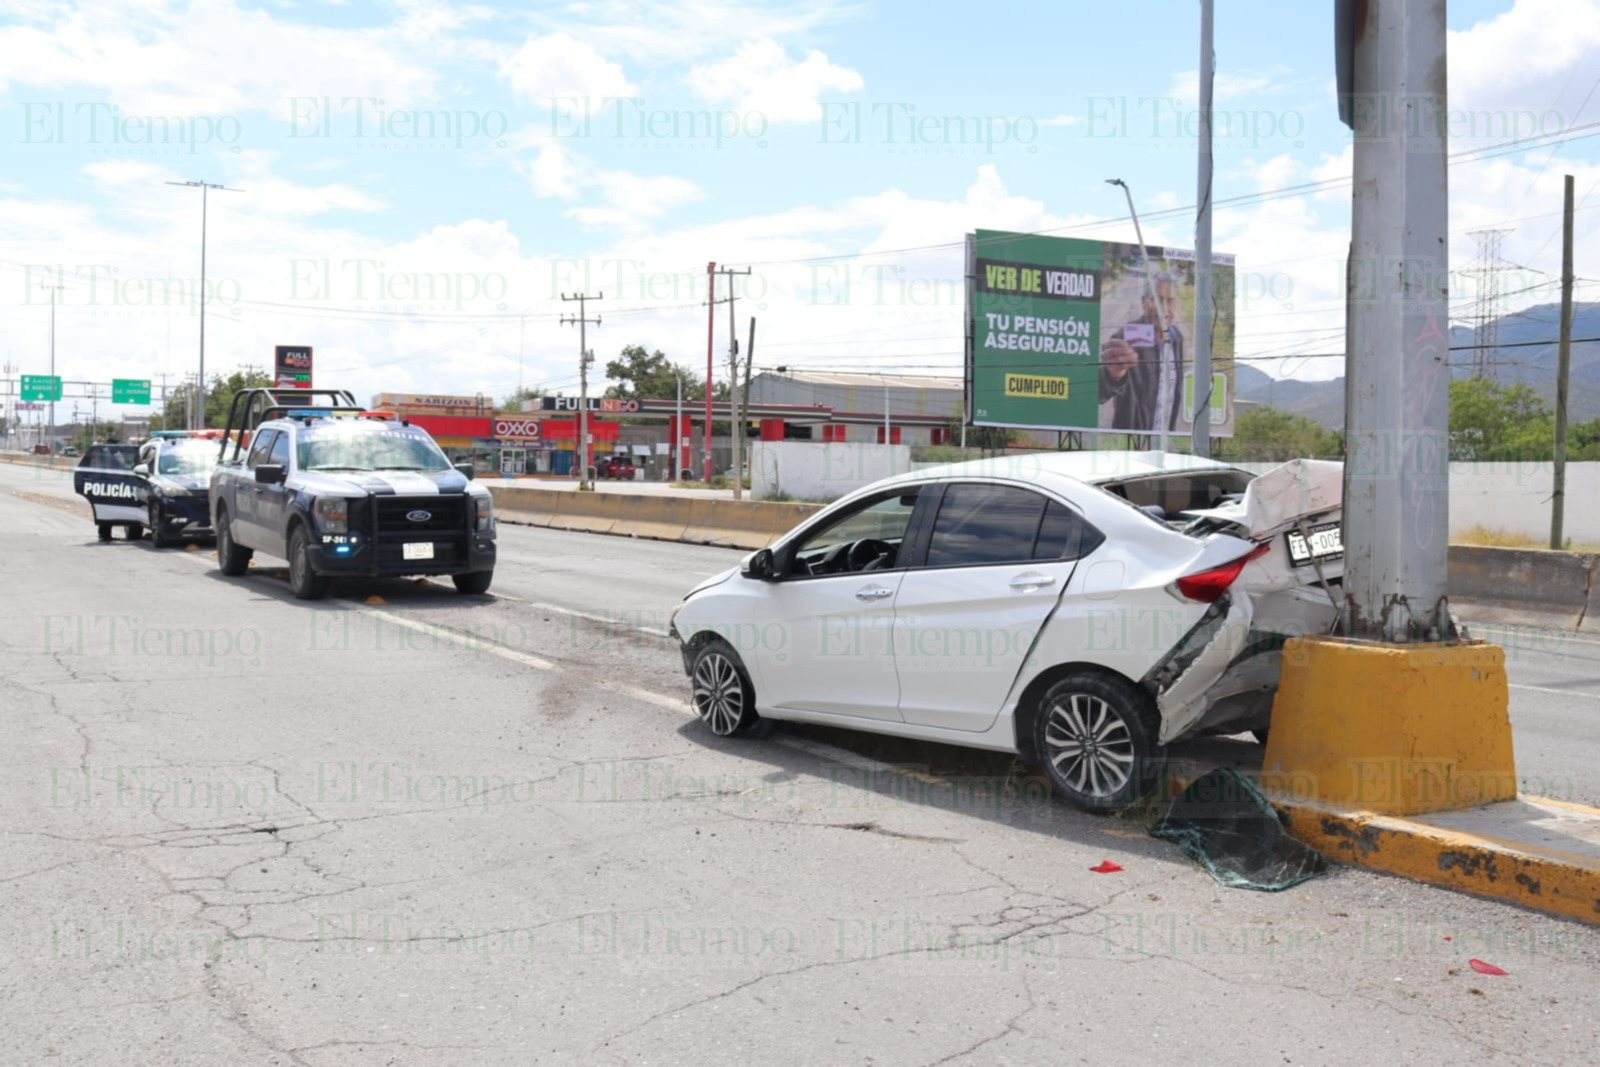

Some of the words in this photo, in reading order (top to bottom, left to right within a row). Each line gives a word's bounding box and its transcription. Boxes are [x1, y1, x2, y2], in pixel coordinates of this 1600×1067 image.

[985, 264, 1017, 291] VER
[1021, 268, 1041, 293] DE
[1046, 270, 1094, 297] VERDAD
[986, 312, 1010, 331] TU
[1014, 314, 1090, 338] PENSIÓN
[984, 332, 1091, 356] ASEGURADA
[1008, 377, 1065, 396] CUMPLIDO
[496, 420, 538, 436] OXXO
[83, 482, 132, 498] POLICÍA
